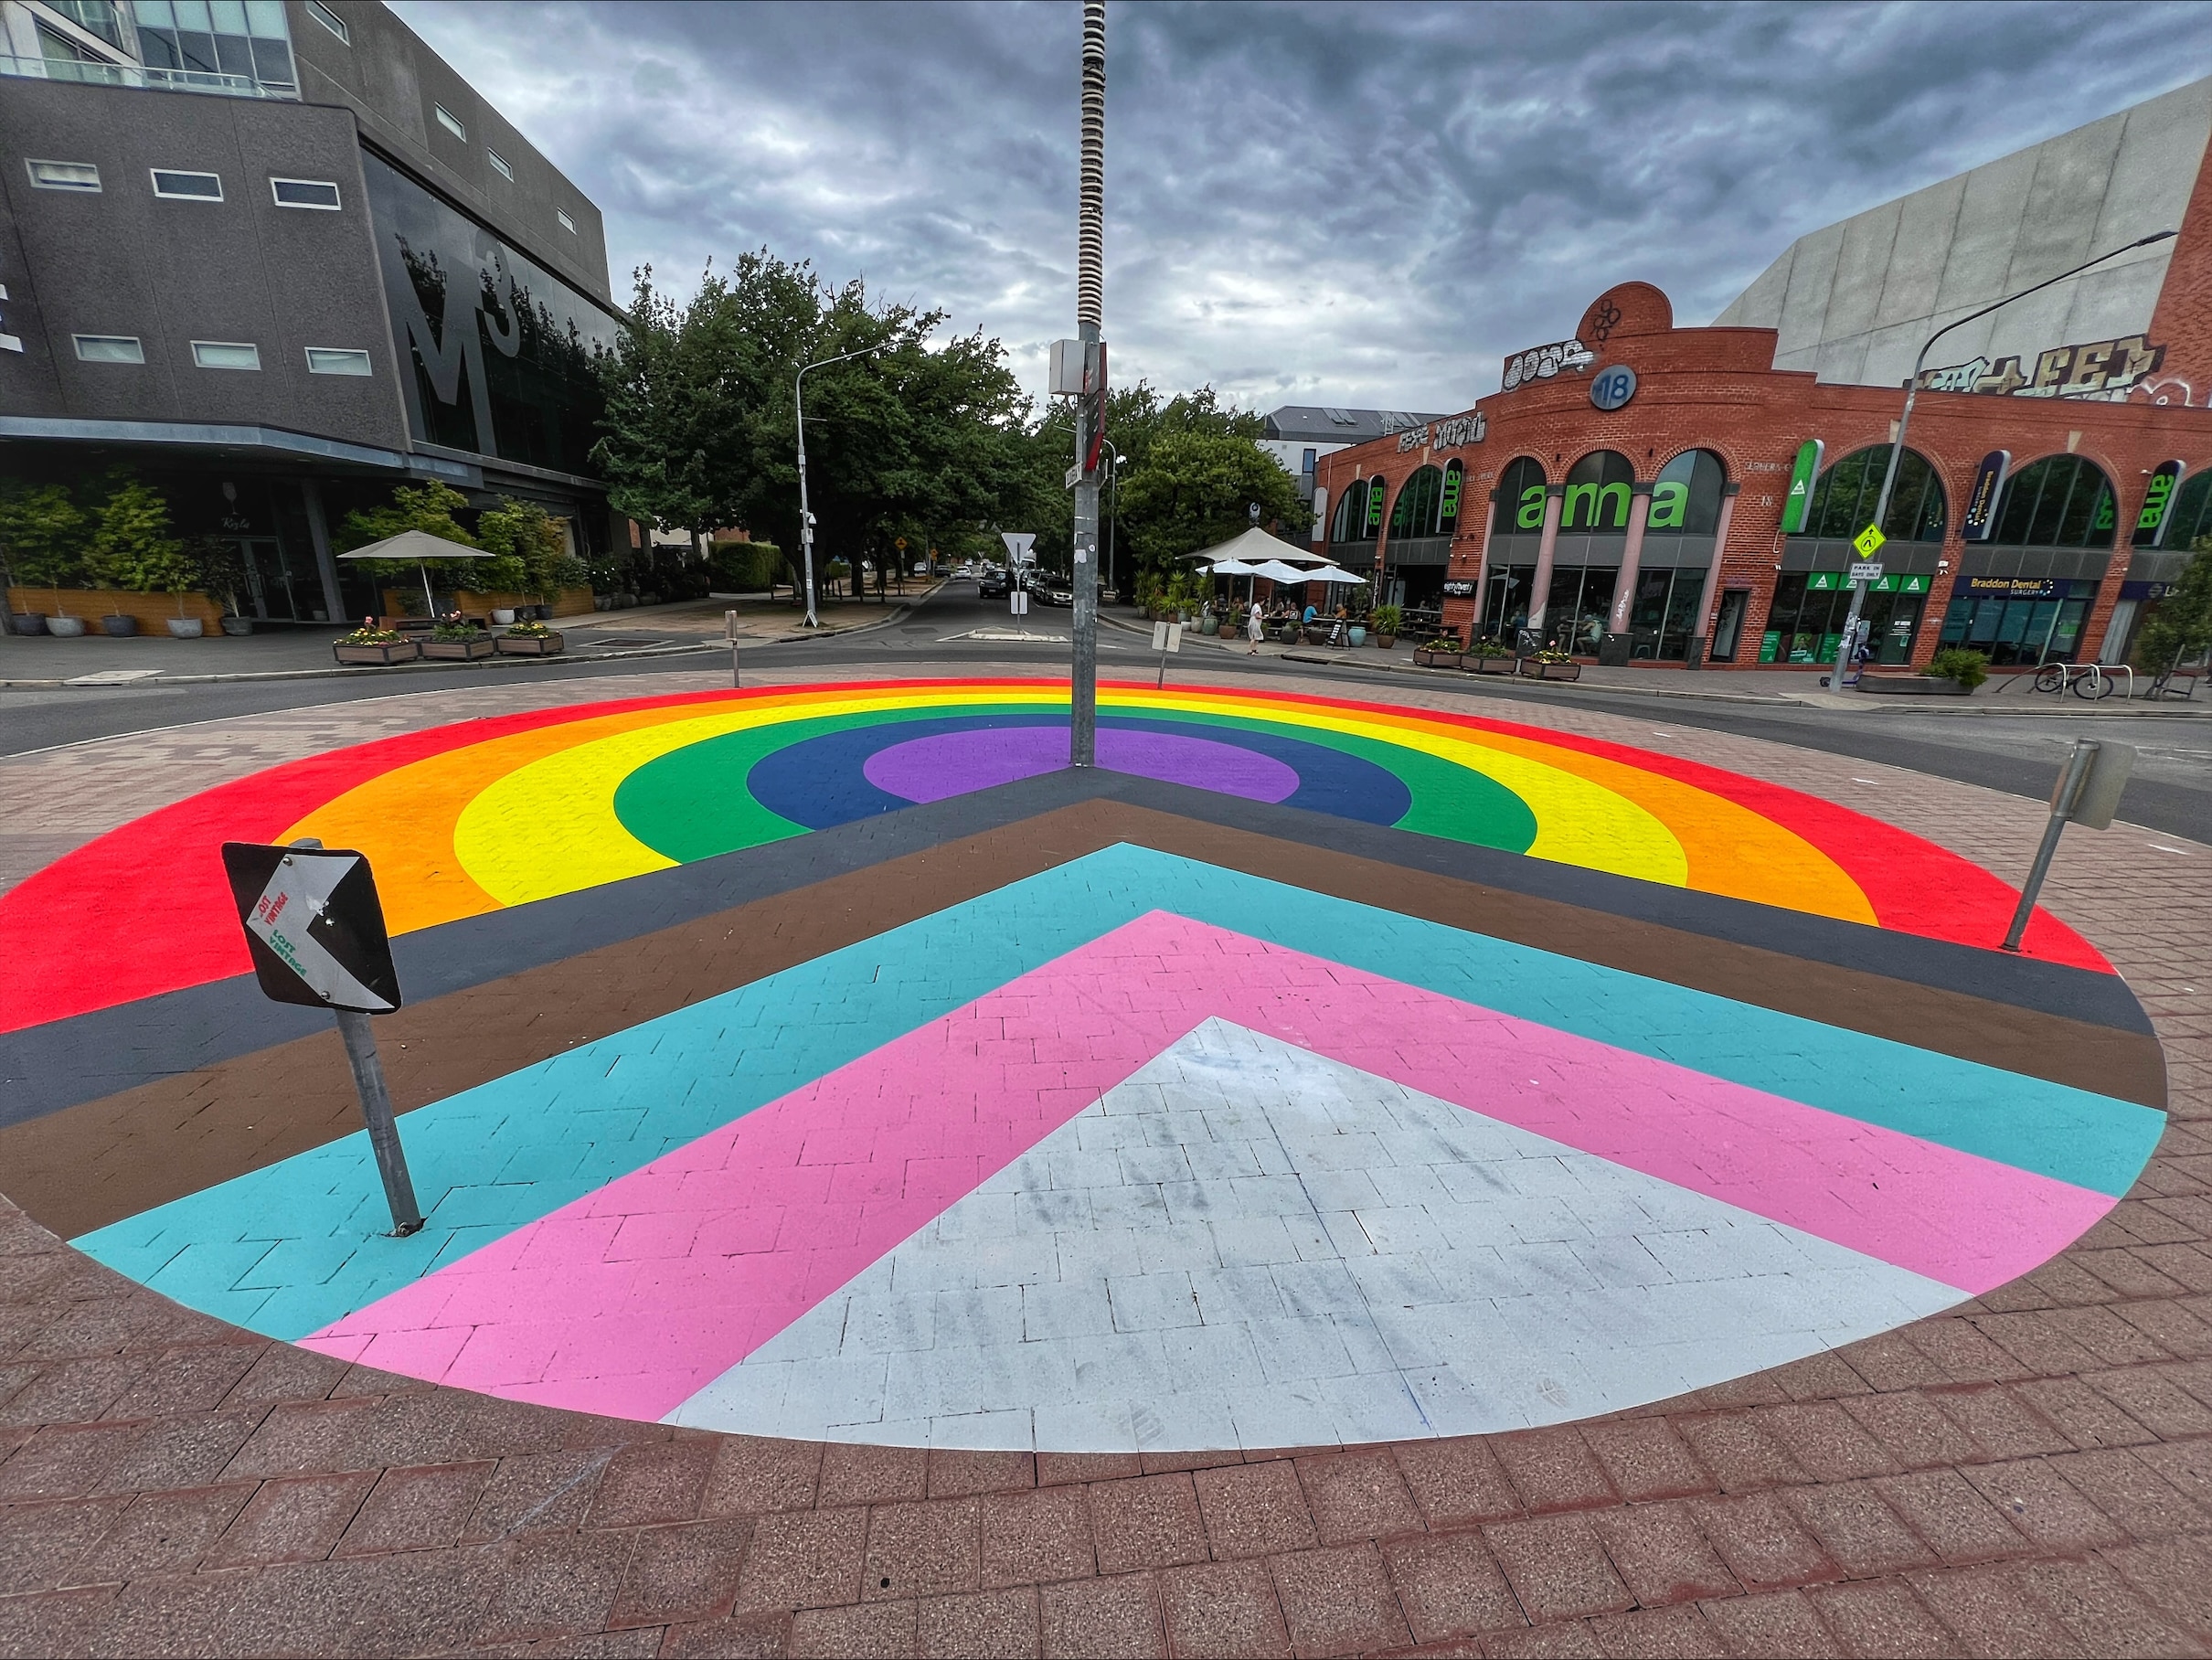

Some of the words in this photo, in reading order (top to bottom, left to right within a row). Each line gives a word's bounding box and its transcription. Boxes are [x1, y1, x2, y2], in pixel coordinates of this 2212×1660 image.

[1599, 374, 1629, 402] 18
[1367, 486, 1384, 526] ama
[1442, 470, 1462, 517] ama
[1516, 482, 1689, 529] ama
[2136, 474, 2175, 528] ama
[1971, 578, 2010, 589] Braddon
[2011, 580, 2042, 590] Dental
[264, 891, 289, 926] VINTAGE
[270, 935, 307, 977] VINTAGE
[273, 929, 296, 953] LOST
